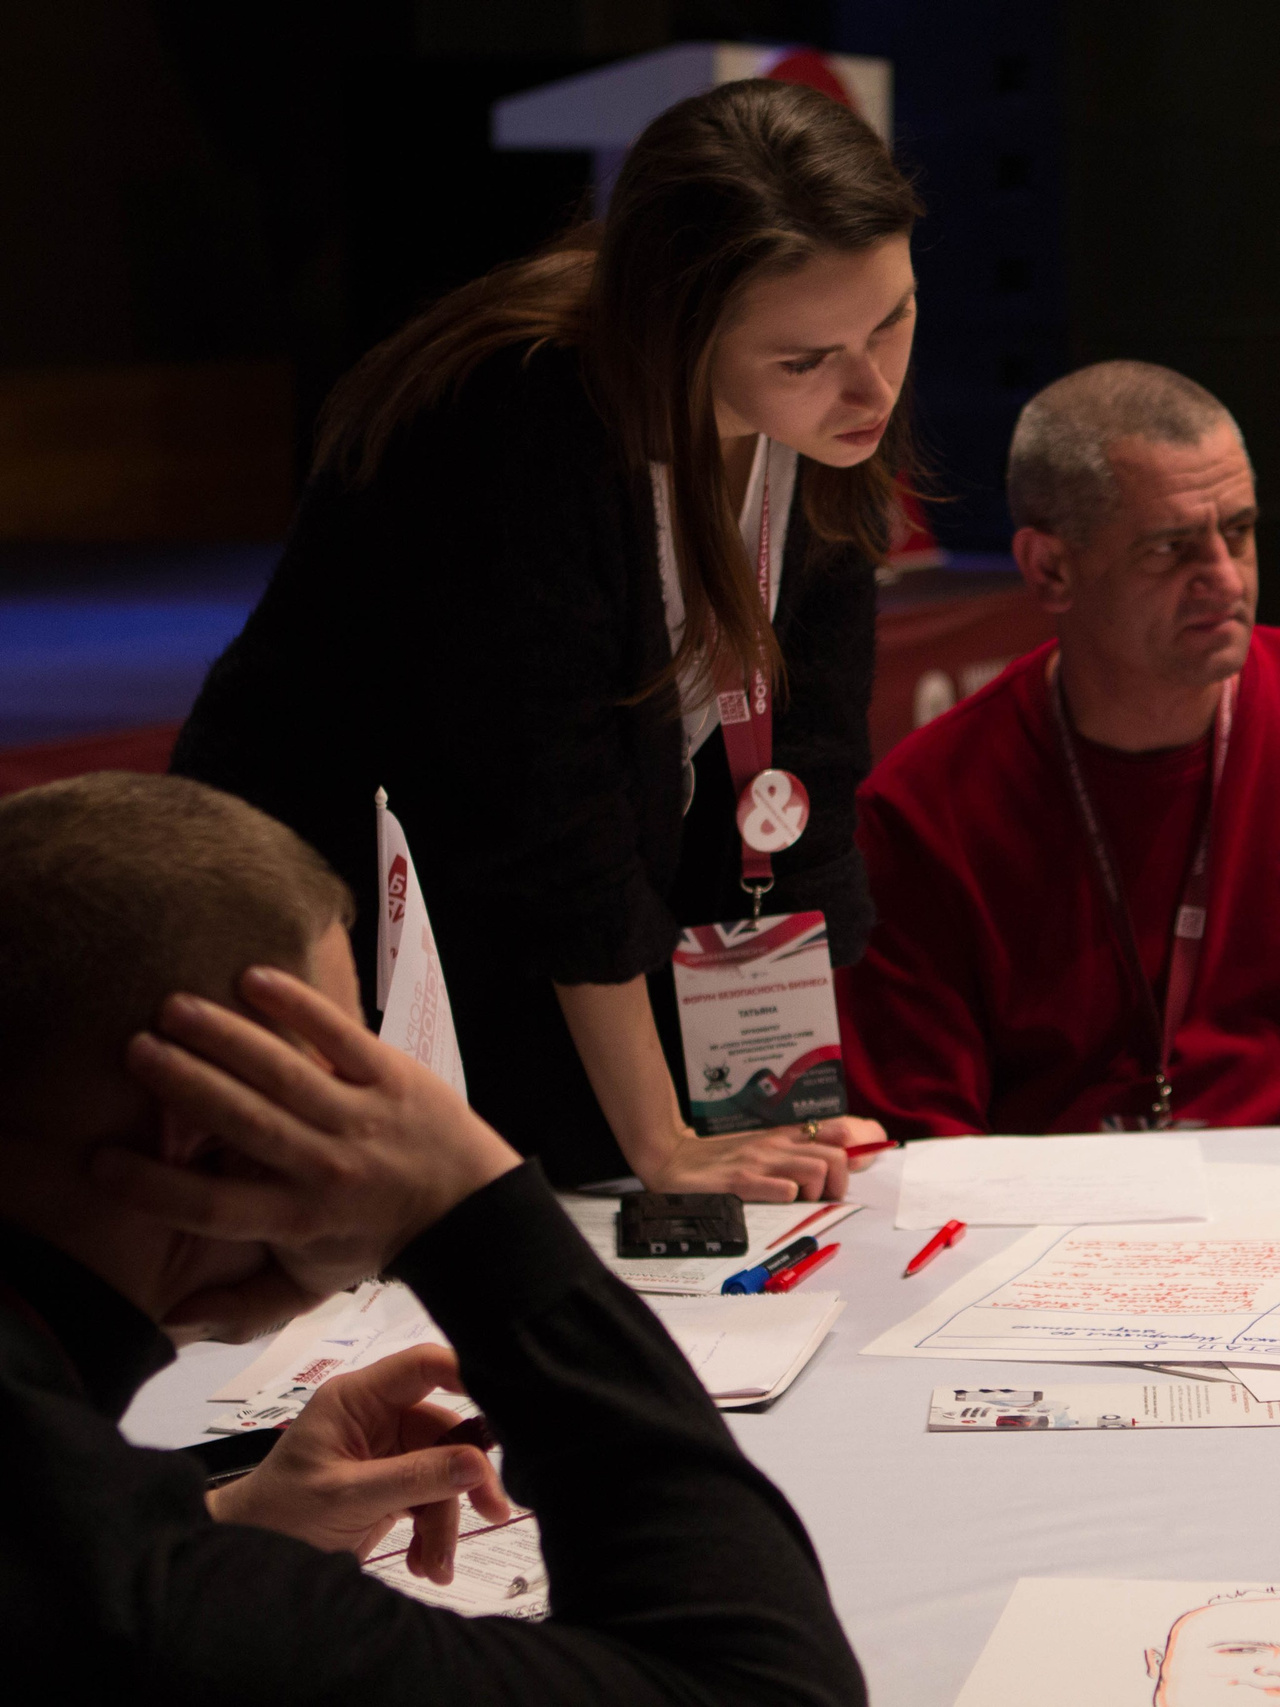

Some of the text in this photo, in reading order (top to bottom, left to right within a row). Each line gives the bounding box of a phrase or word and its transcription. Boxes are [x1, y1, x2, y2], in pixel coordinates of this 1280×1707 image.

[682, 977, 829, 1005] ФОРУМ БЕЗОПАСНОСТЬ БИЗНЕСА
[738, 1006, 778, 1019] ТАТЬЯНА
